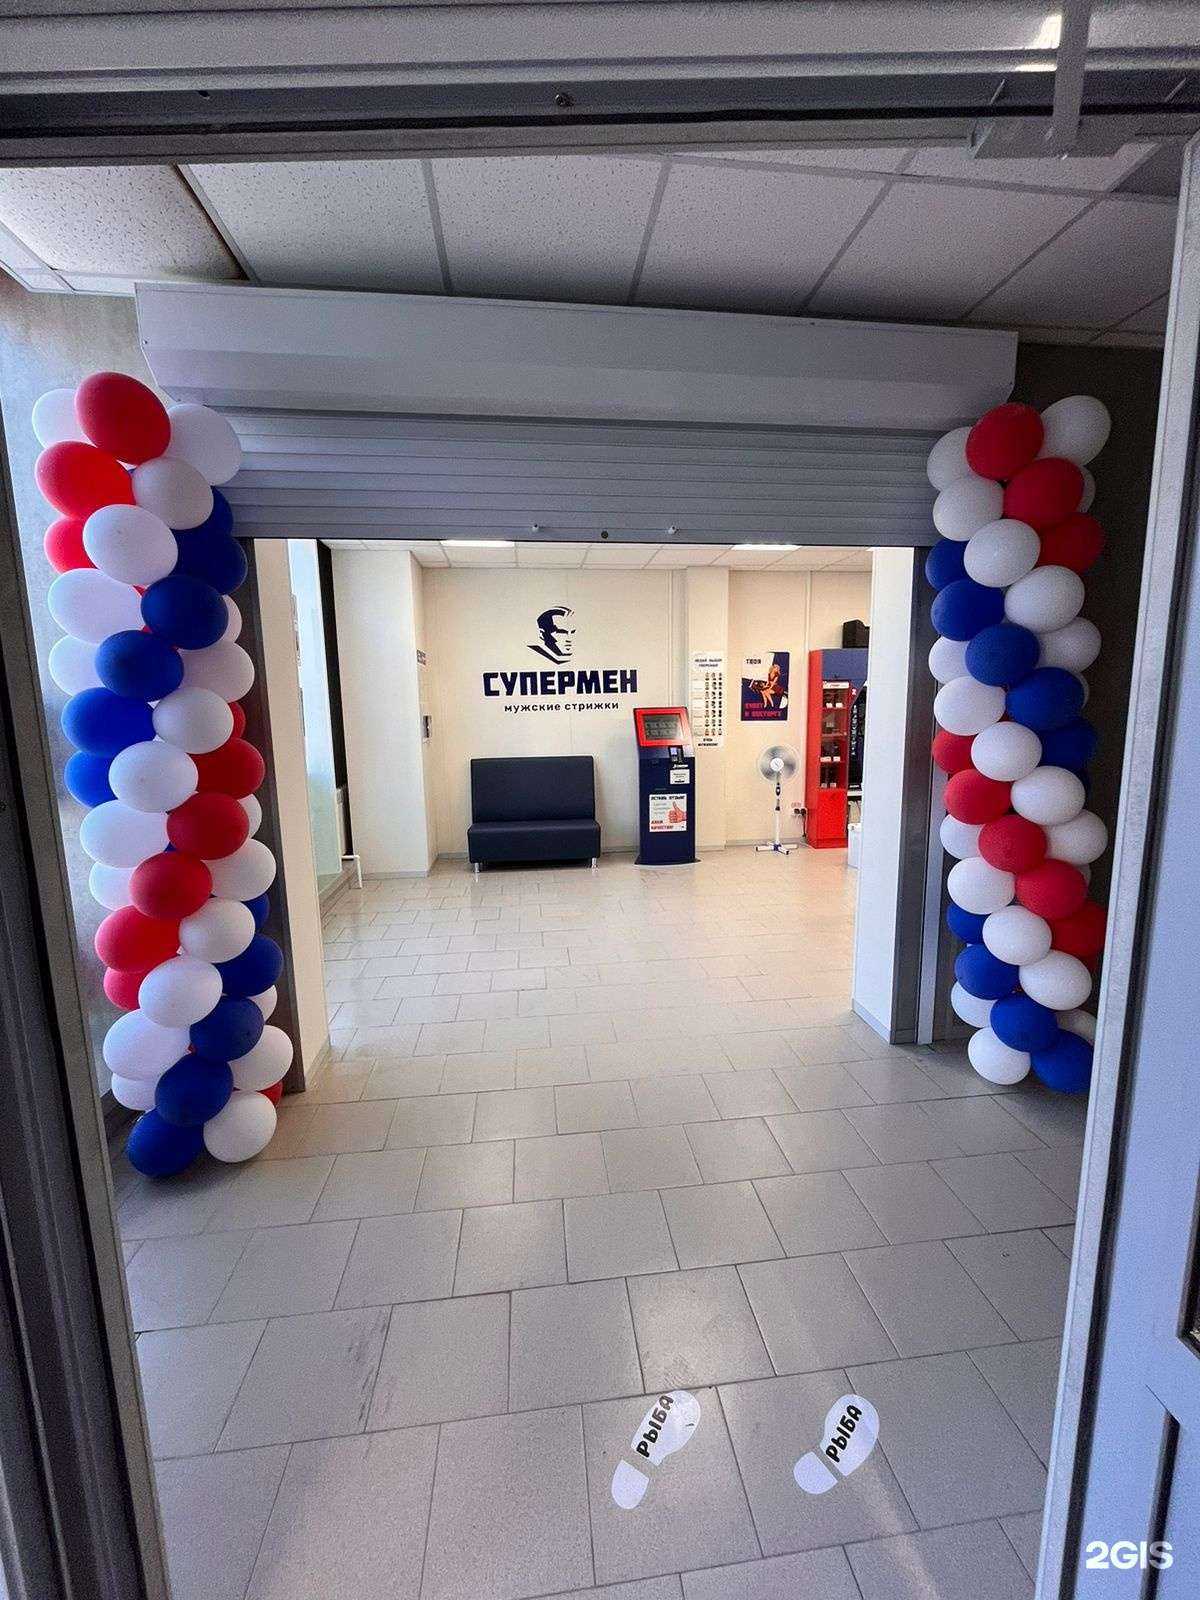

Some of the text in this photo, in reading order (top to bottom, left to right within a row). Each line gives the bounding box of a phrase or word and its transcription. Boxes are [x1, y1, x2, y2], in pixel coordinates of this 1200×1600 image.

[483, 670, 638, 697] СУПЕРМЕН
[504, 702, 619, 714] мужские стрижки
[636, 1395, 674, 1458] РЫБА
[825, 1404, 862, 1463] РЫБА
